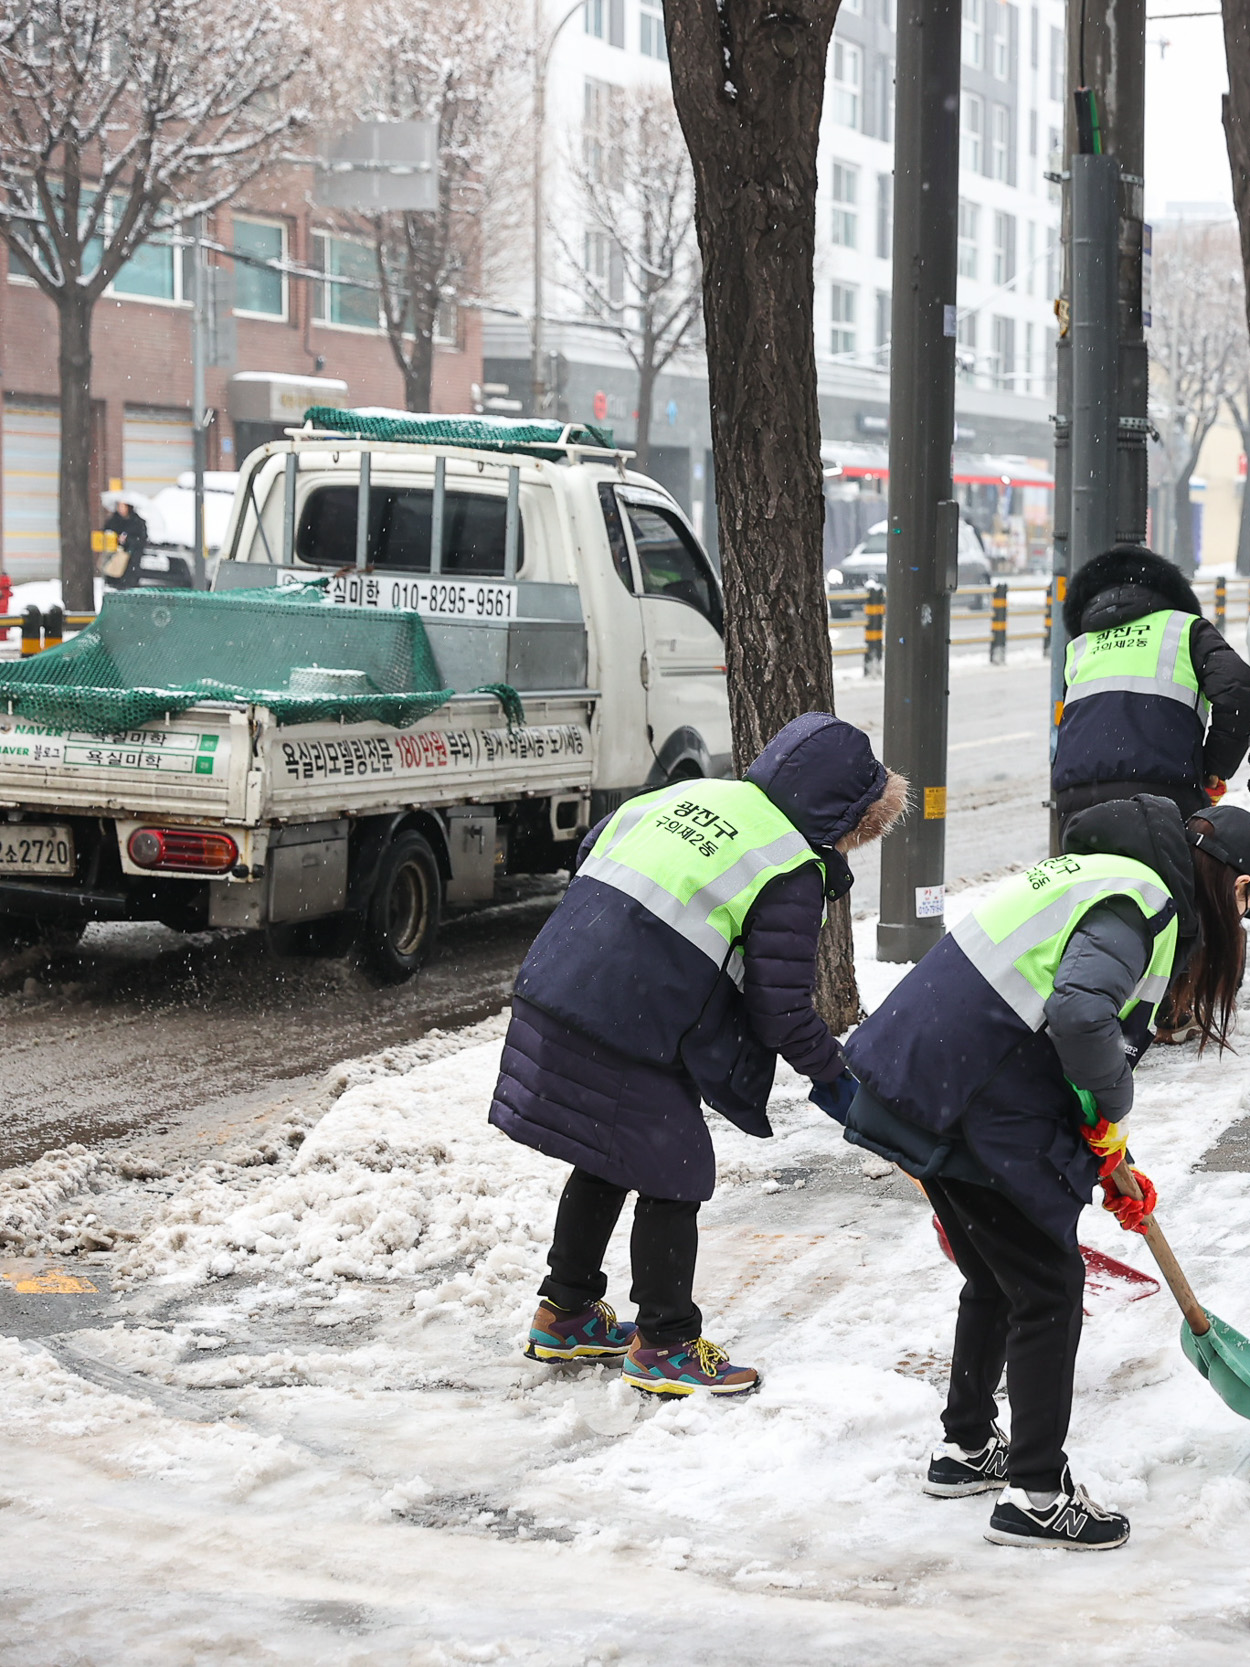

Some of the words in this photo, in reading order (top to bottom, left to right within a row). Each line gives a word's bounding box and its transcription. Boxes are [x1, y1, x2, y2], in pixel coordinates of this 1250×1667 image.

[323, 575, 379, 606] 실미학
[392, 582, 512, 617] 010-8295-9561
[1090, 638, 1148, 655] 구의제2동
[14, 724, 62, 742] NAVER
[0, 745, 30, 756] AVER
[34, 744, 60, 761] 블로그
[86, 750, 162, 769] 욕실미학
[282, 737, 394, 780] 욕실리모델링전문
[394, 730, 448, 768] 180만원
[445, 730, 473, 766] 부터
[656, 815, 719, 857] 구의제2동
[673, 800, 739, 840] 광진구
[1053, 1507, 1088, 1538] N
